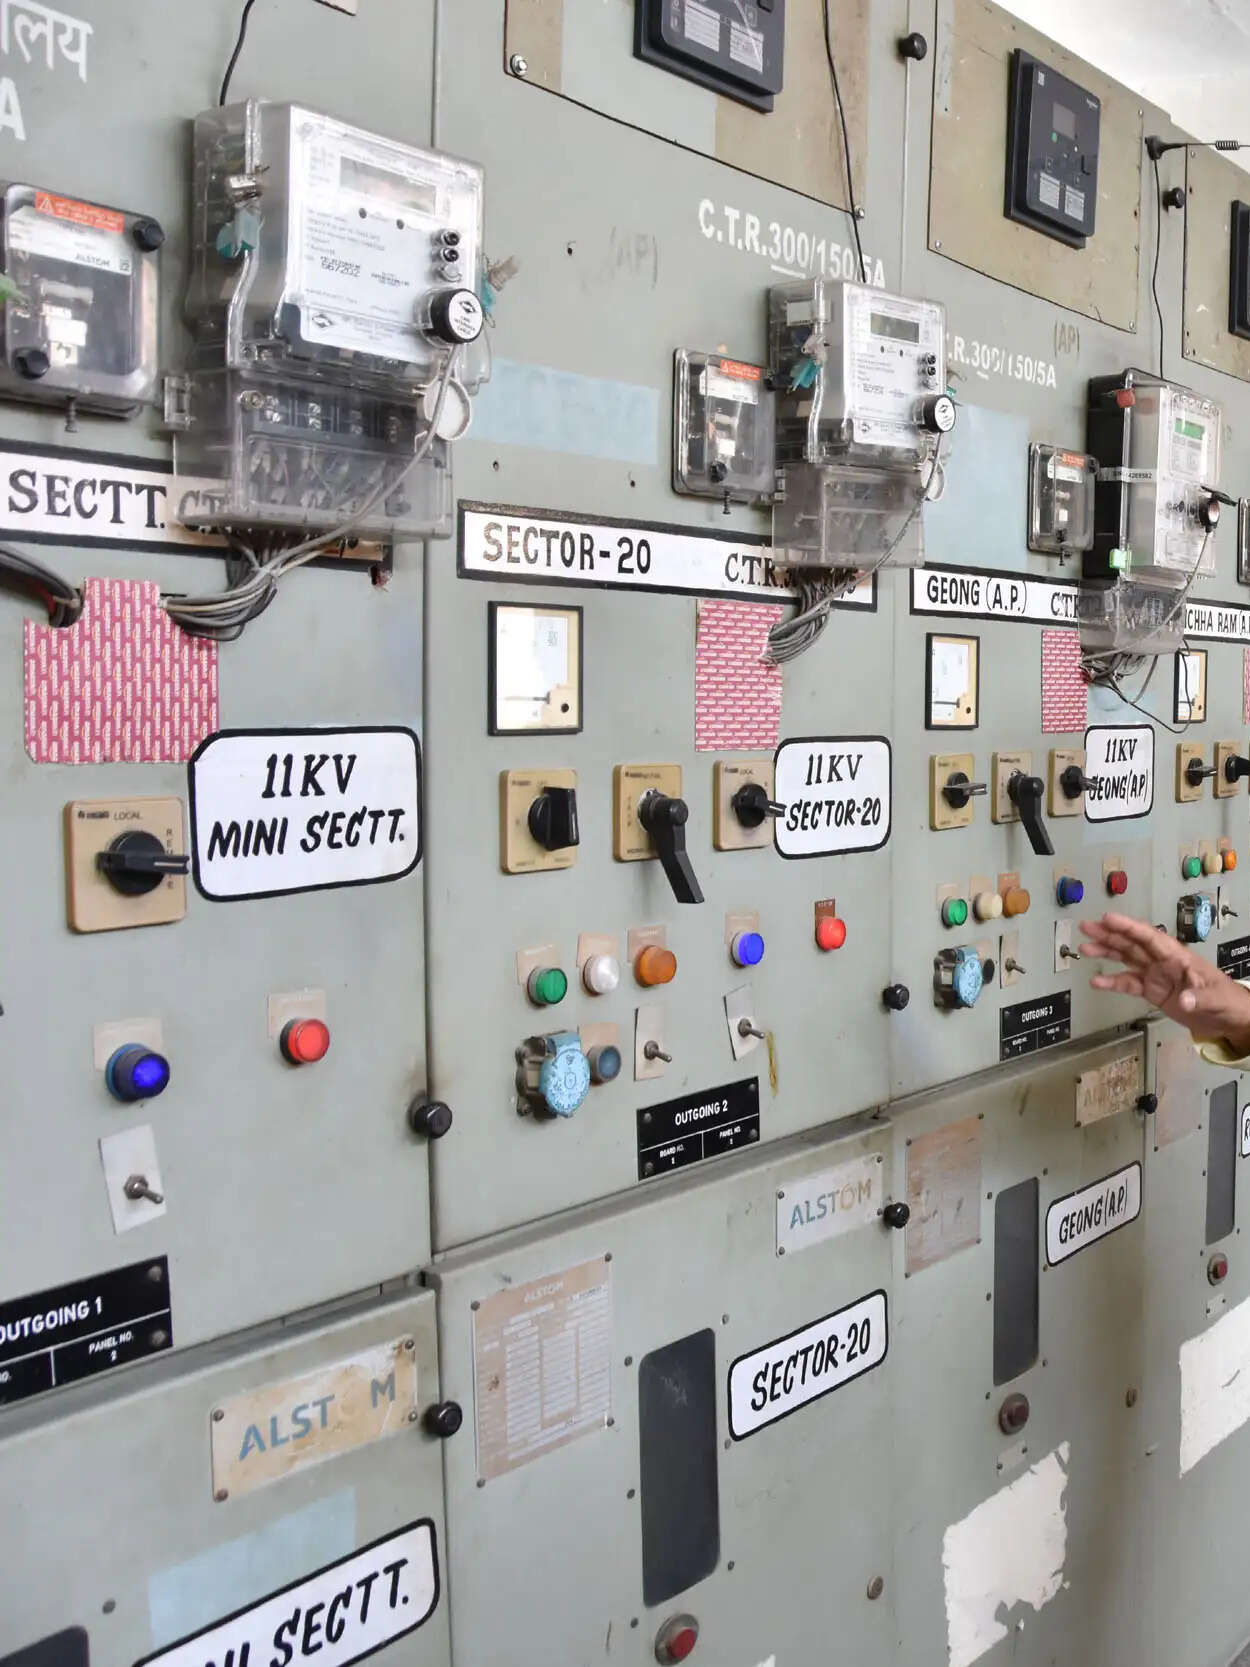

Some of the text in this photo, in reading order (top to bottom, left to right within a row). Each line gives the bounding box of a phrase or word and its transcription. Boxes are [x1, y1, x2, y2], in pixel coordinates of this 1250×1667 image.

[8, 468, 168, 529] SECTT.
[483, 521, 651, 575] SECTOR-20
[926, 575, 981, 607] GEONG
[1104, 738, 1138, 763] 11KV
[805, 753, 864, 786] 11KV
[207, 805, 406, 862] MINI SECTT.
[1021, 1006, 1048, 1023] OUTGOING
[674, 1099, 728, 1126] OUTGOING 2
[659, 1145, 677, 1158] BOARD
[789, 1177, 872, 1230] ALSTOM
[95, 1295, 103, 1315] 1
[88, 1336, 118, 1355] PANEL
[750, 1317, 871, 1413] SECTOR-20
[269, 1557, 409, 1667] SECTT.
